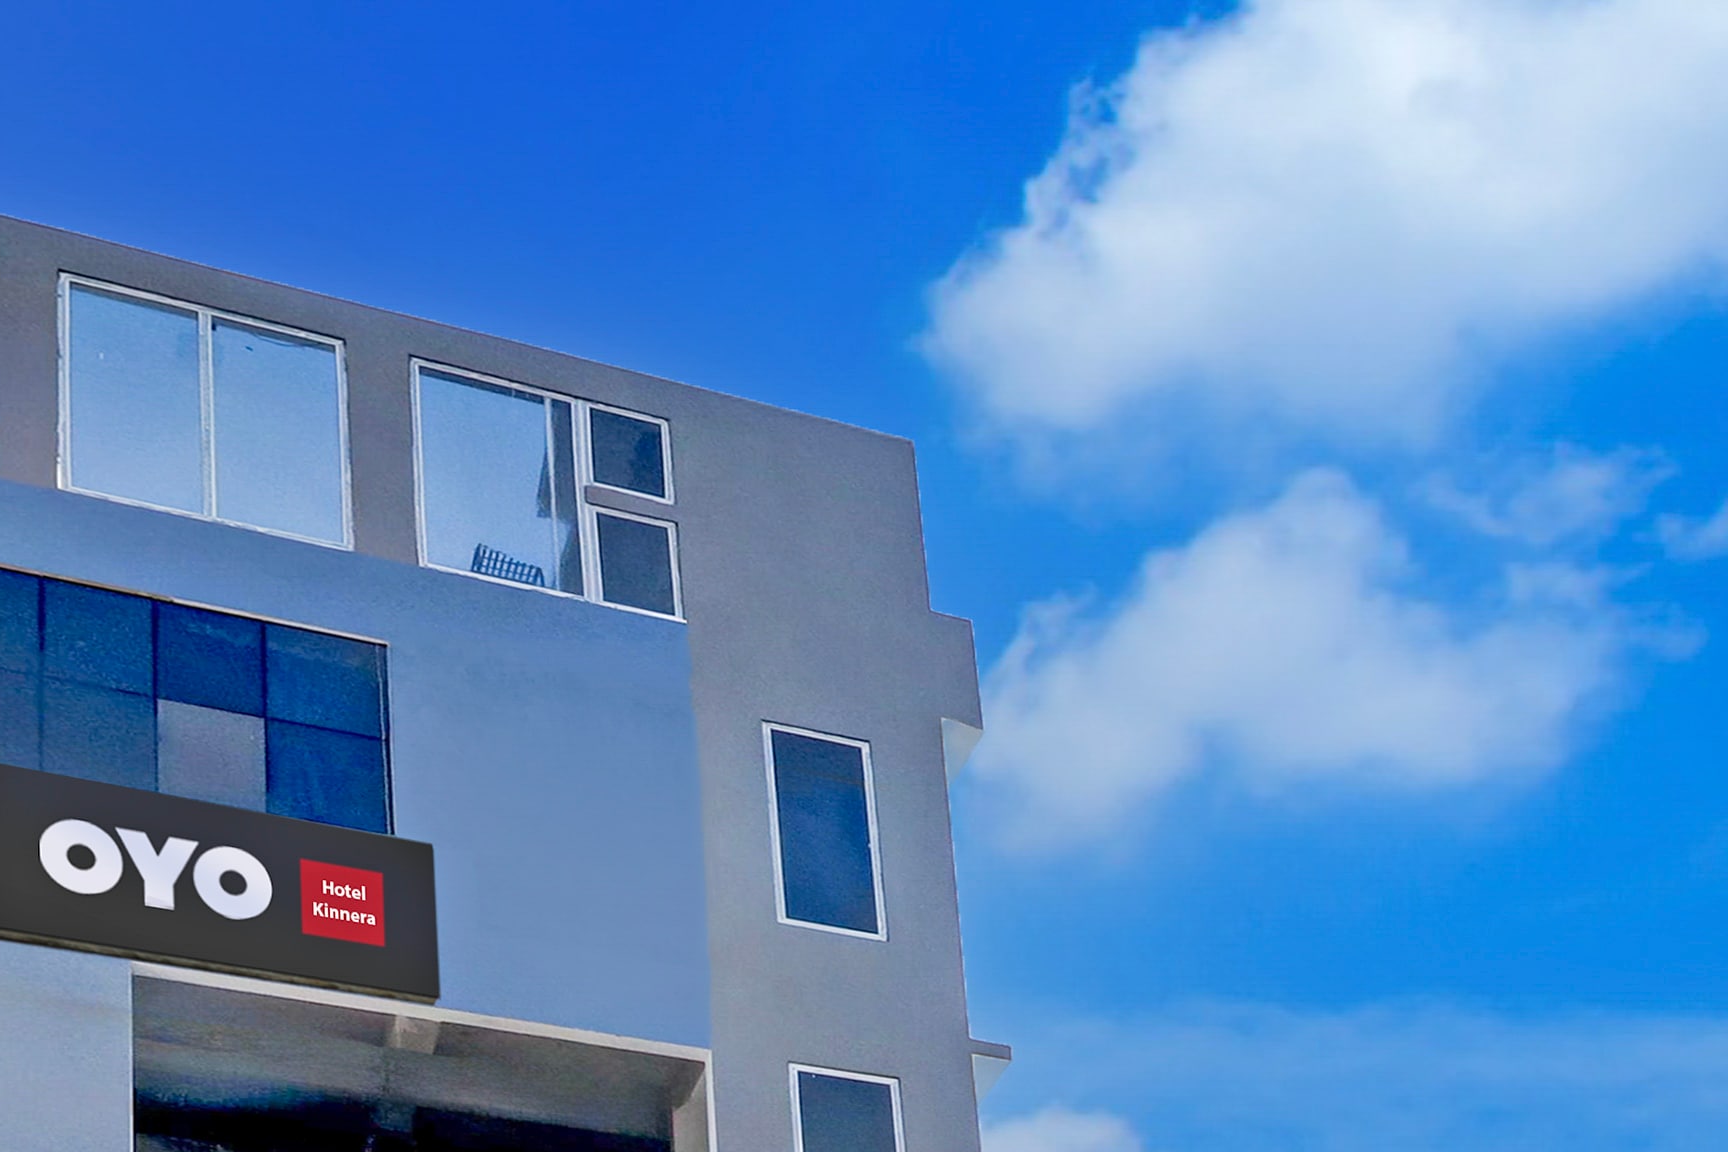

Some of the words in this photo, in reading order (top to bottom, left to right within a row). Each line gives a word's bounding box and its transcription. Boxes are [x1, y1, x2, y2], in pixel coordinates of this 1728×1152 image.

[39, 818, 273, 920] OYO
[322, 880, 367, 901] Hotel
[312, 902, 376, 926] Kinnera
